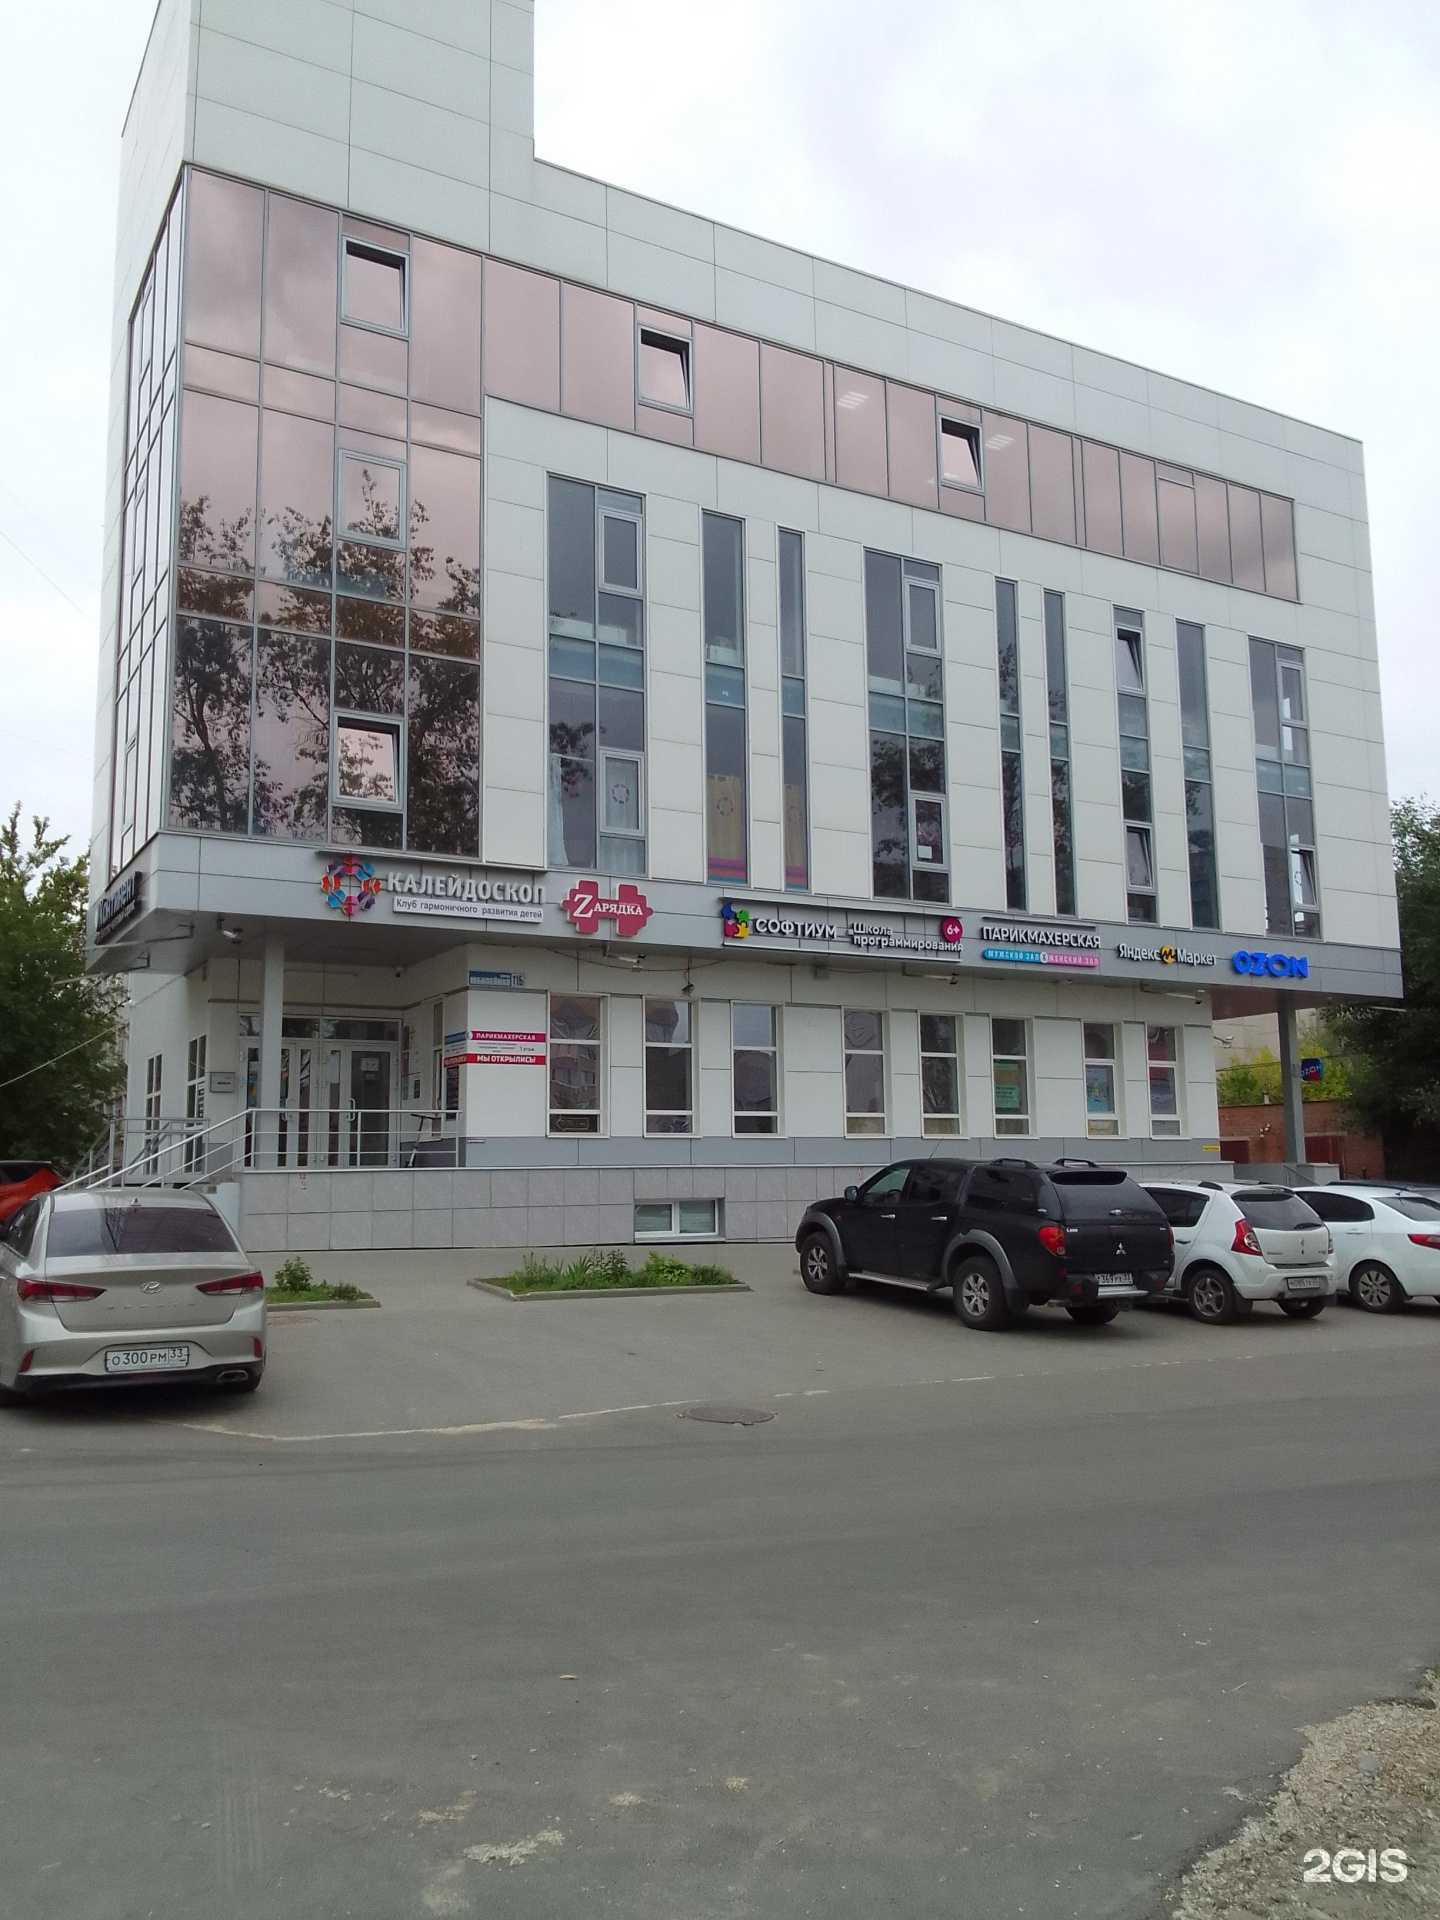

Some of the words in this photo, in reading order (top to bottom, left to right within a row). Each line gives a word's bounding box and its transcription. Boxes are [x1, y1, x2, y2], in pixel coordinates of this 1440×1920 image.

[387, 871, 545, 904] КАЛЕЙДОСКОП
[396, 899, 417, 910] Клуб
[420, 902, 478, 914] гармоничного
[482, 906, 518, 918] развития
[520, 909, 543, 920] детей
[756, 919, 837, 939] СОФТИУМ
[853, 922, 893, 935] Школа
[946, 924, 960, 935] 6+
[983, 926, 1101, 948] ПАРИКМАХЕРСКАЯ
[853, 934, 964, 952] программирования
[1119, 943, 1161, 961] Яндекс
[1177, 947, 1217, 966] Маркет
[1232, 951, 1309, 977] OZON
[476, 1032, 536, 1041] ПАРИКМАХЕРСКАЯ
[491, 1055, 536, 1063] ОТКРЫЛИСЬ
